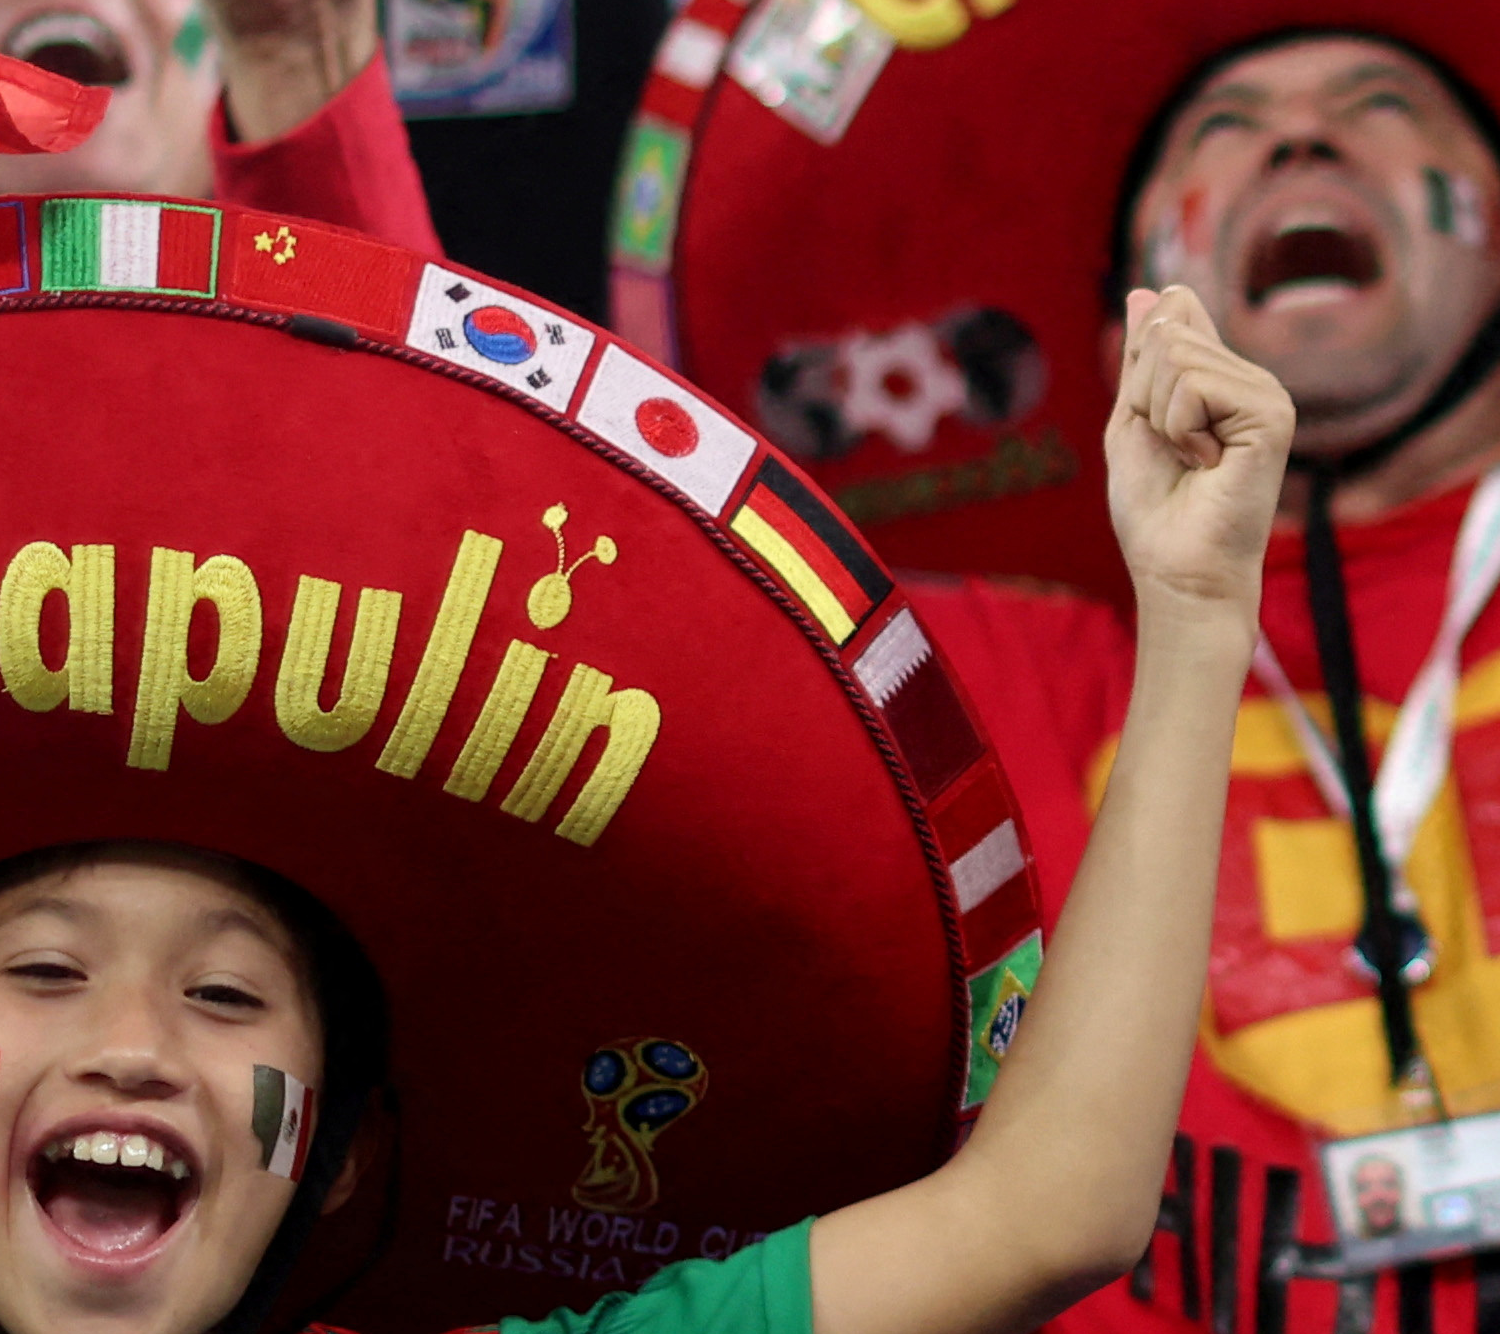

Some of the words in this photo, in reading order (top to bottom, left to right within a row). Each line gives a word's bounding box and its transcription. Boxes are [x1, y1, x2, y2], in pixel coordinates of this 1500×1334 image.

[446, 1195, 522, 1237] FIFA
[548, 1206, 681, 1256] WORLD
[443, 1233, 625, 1284] RUSSIA
